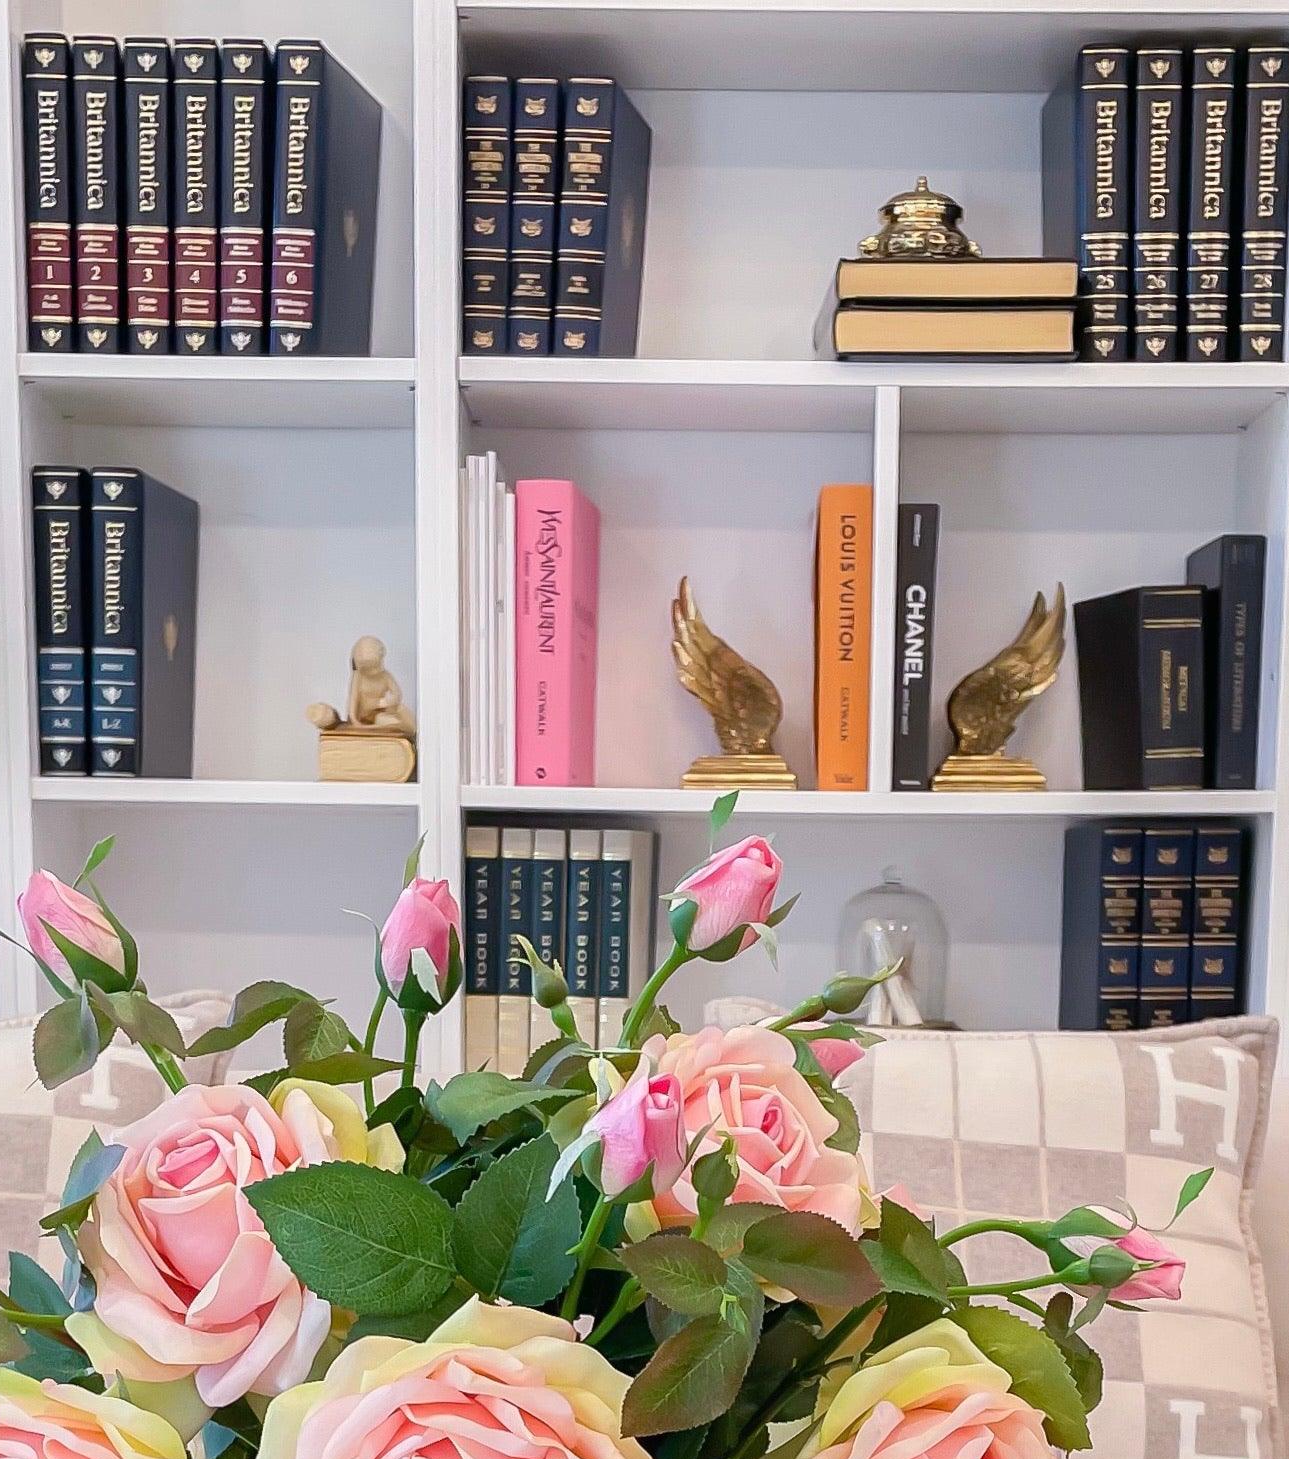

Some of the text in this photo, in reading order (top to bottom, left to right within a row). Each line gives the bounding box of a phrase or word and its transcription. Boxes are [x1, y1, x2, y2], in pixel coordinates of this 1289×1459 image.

[37, 90, 60, 209] Britannica
[85, 91, 108, 210] Britannica
[138, 94, 161, 212] Britannica
[186, 96, 208, 213] Britannica
[233, 96, 256, 213] Britannica
[287, 97, 310, 214] Britannica
[1096, 100, 1118, 218] Britannica
[1149, 100, 1172, 219] Britannica
[1203, 100, 1227, 219] Britannica
[1257, 98, 1282, 217] Britannica
[46, 265, 54, 279] 1
[90, 265, 102, 281] 2
[142, 268, 153, 282] 3
[189, 270, 200, 284] 4
[235, 270, 247, 284] 5
[285, 271, 298, 284] 6
[48, 520, 71, 635] Britannica
[104, 521, 125, 635] Britannica
[838, 514, 857, 662] LOUIS VUITTON
[902, 584, 927, 687] CHANEL
[475, 865, 488, 988] YEAR BOOK
[509, 866, 522, 921] YEAR
[541, 867, 554, 963] YEAR BO
[576, 867, 591, 991] YEAR BOOK
[610, 869, 622, 991] YEAR BOOK
[1139, 1044, 1245, 1161] H
